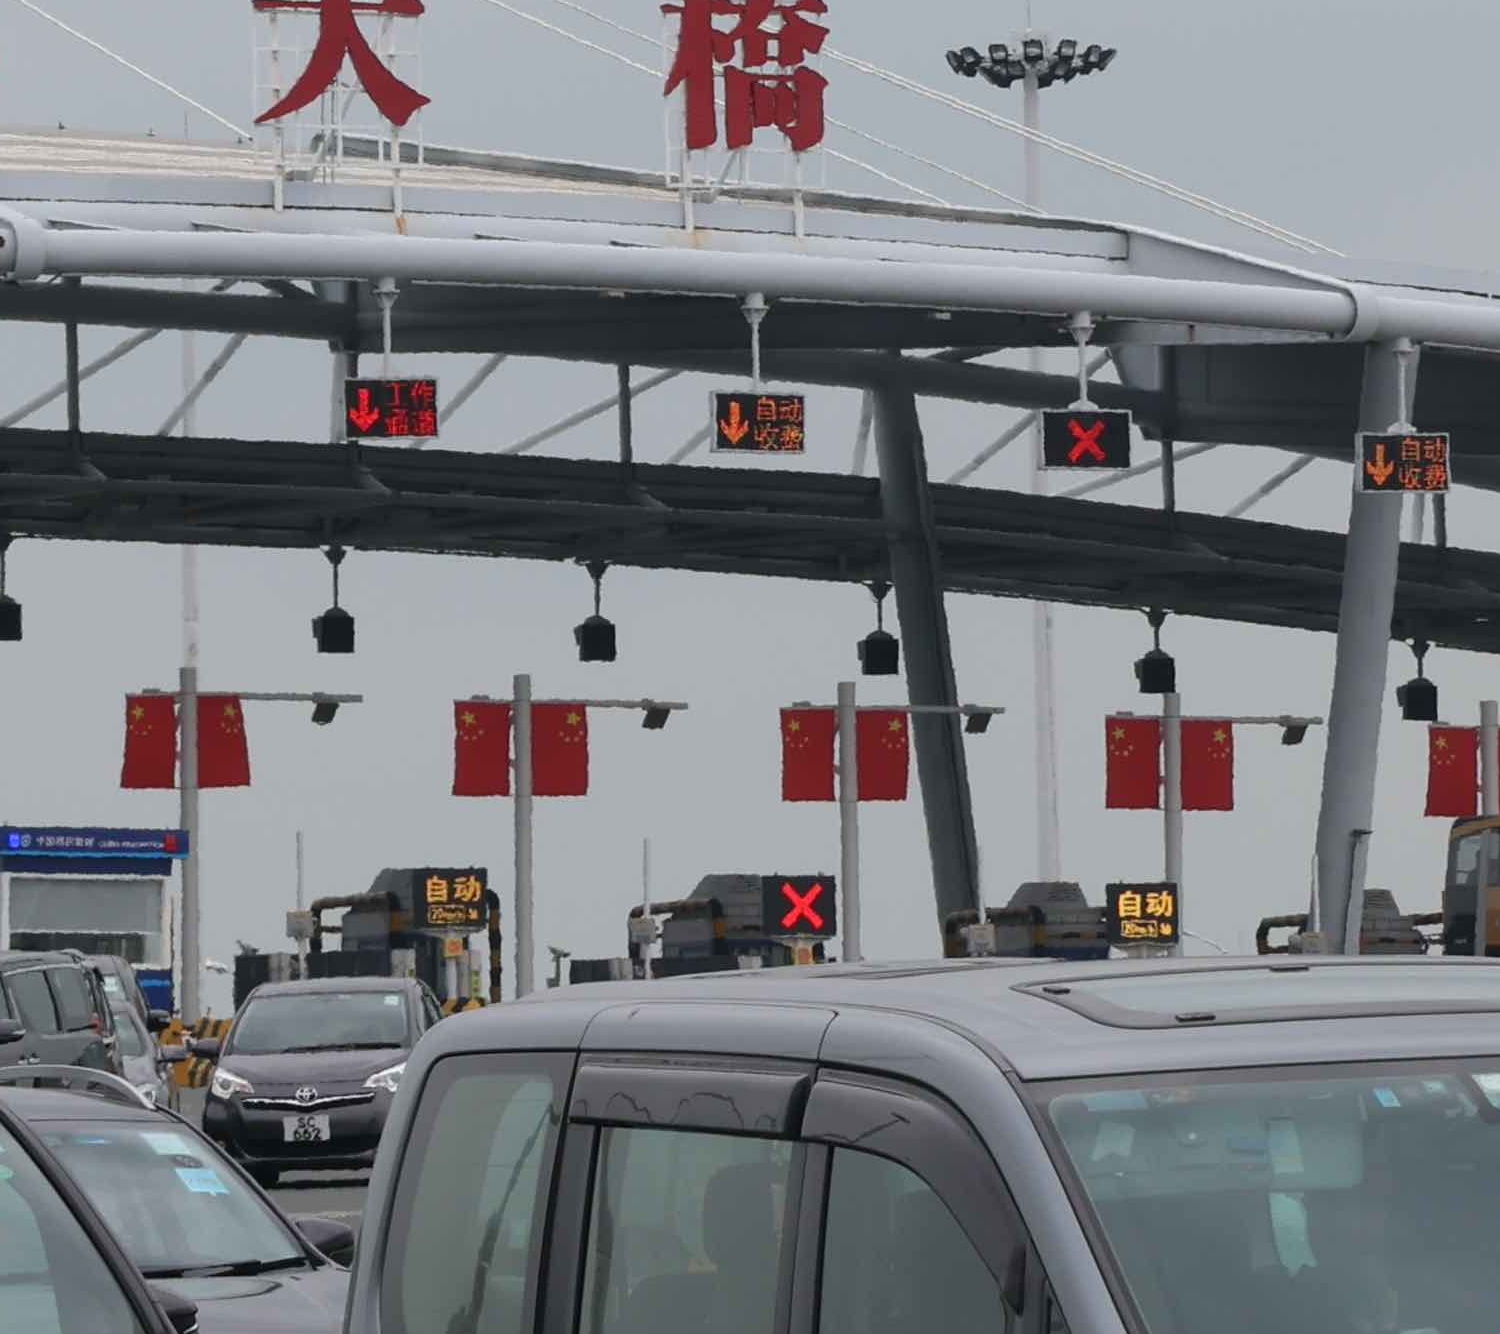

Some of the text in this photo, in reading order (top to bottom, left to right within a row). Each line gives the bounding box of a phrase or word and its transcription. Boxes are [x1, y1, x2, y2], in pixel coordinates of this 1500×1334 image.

[384, 381, 436, 407] 工作
[756, 396, 803, 422] 自动
[1401, 436, 1447, 462] 自动
[1399, 464, 1447, 490] 收费
[426, 875, 482, 903] 自动
[1118, 890, 1173, 918] 自动
